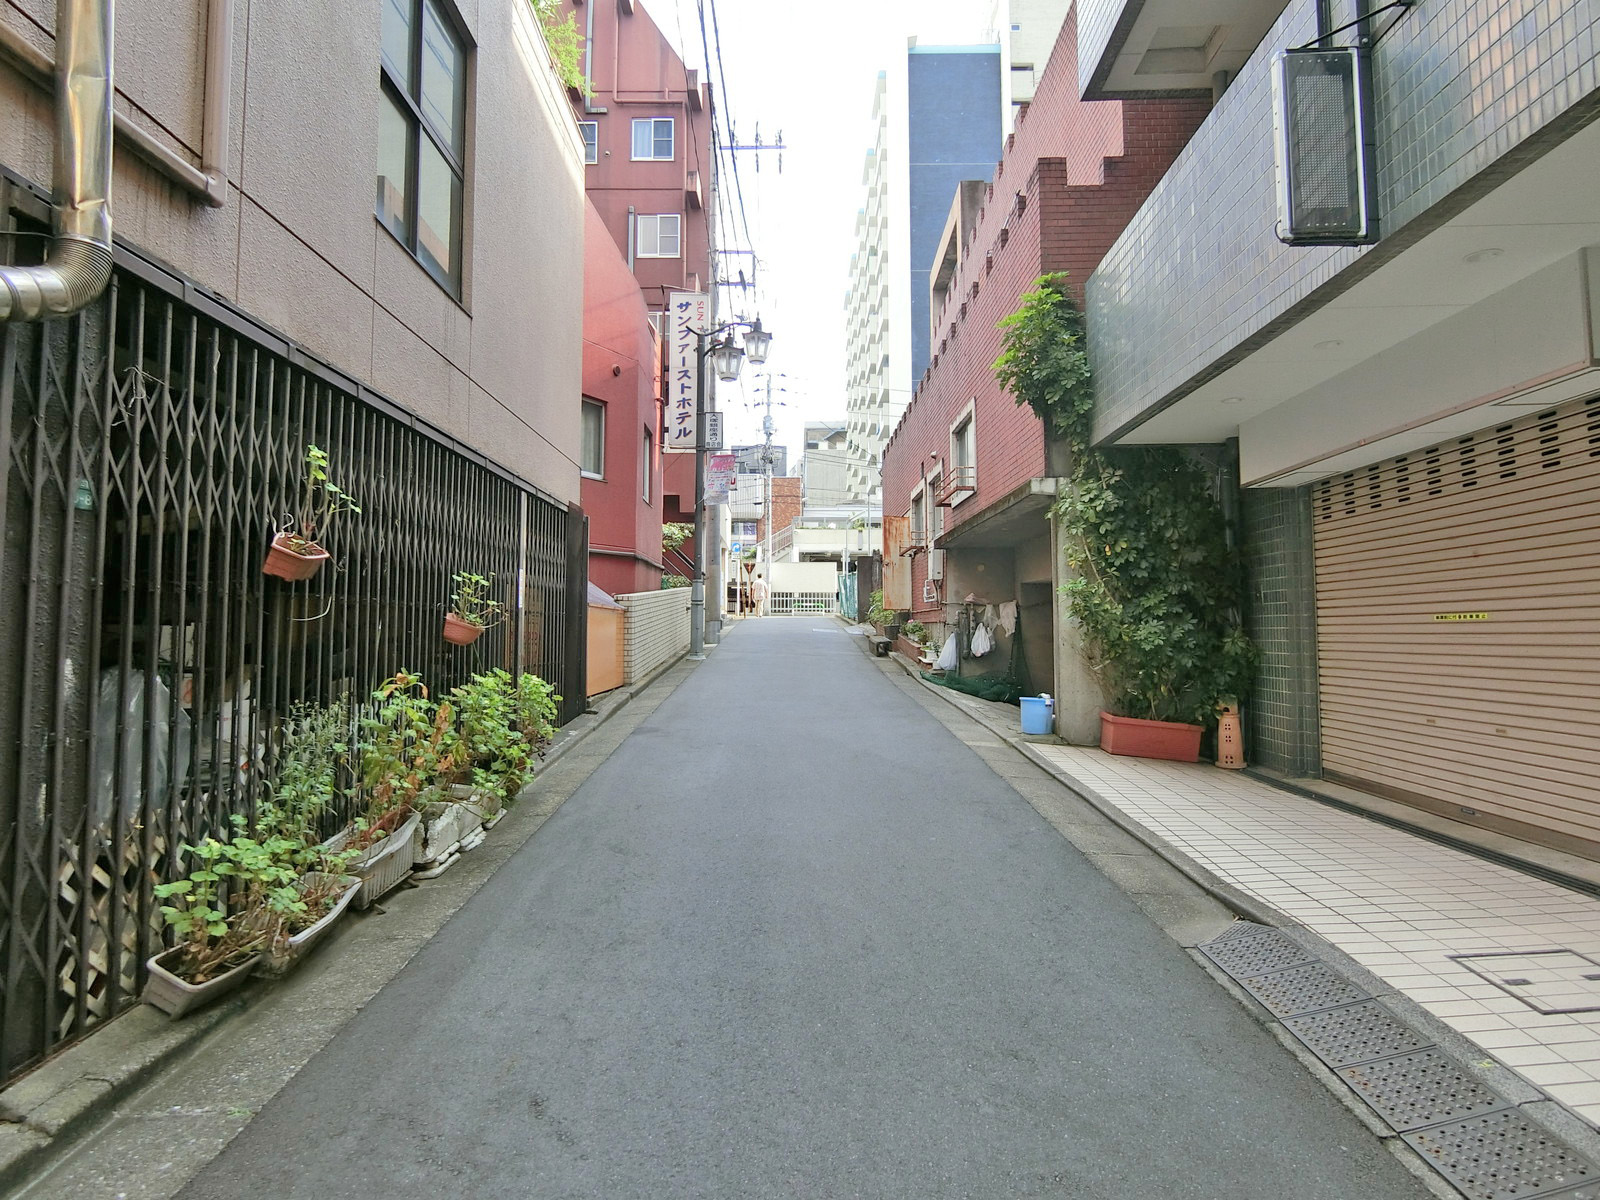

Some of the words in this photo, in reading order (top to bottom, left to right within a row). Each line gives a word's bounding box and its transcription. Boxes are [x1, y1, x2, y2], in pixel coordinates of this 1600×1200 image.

[696, 300, 705, 321] SUN
[675, 301, 692, 439] サンファーストホテル
